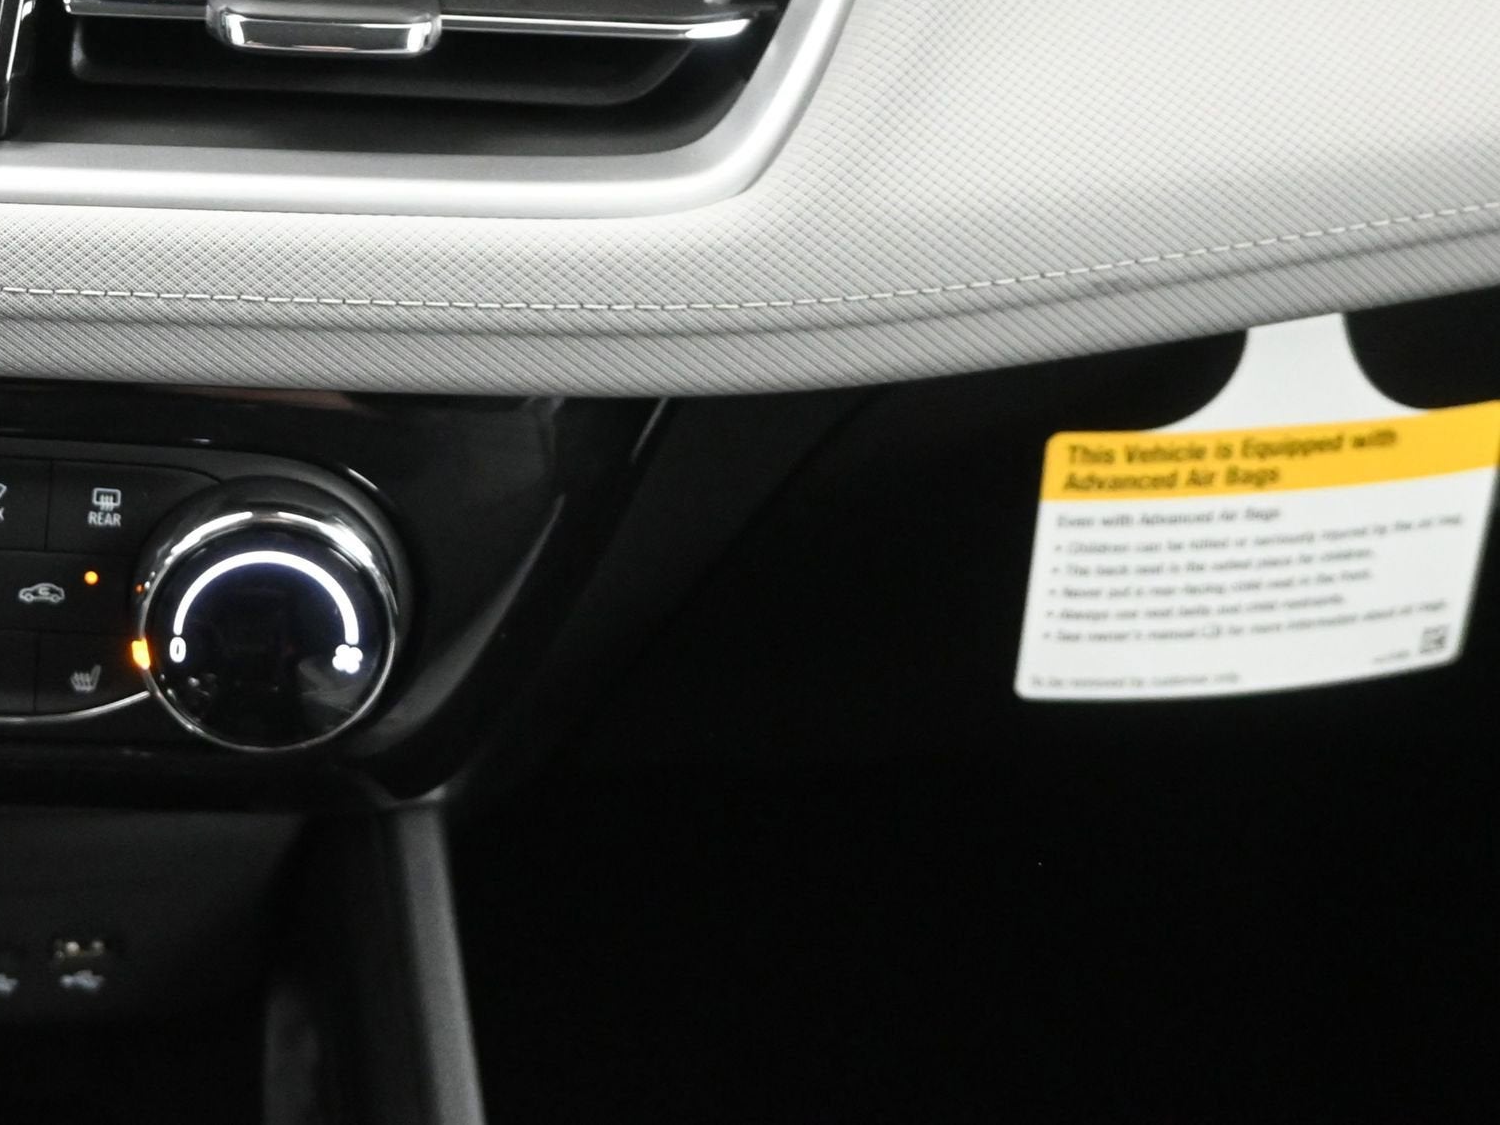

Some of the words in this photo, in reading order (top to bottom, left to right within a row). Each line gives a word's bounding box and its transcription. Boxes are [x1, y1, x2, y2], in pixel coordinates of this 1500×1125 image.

[1066, 443, 1117, 465] This
[1123, 442, 1207, 464] Vehicle
[1215, 441, 1234, 460] is
[1240, 434, 1344, 459] Equipped
[1351, 428, 1397, 449] with
[1062, 470, 1179, 492] Advanced
[1185, 469, 1215, 488] Air
[1225, 465, 1281, 487] Bags
[88, 511, 121, 528] REAR
[170, 636, 187, 664] 0
